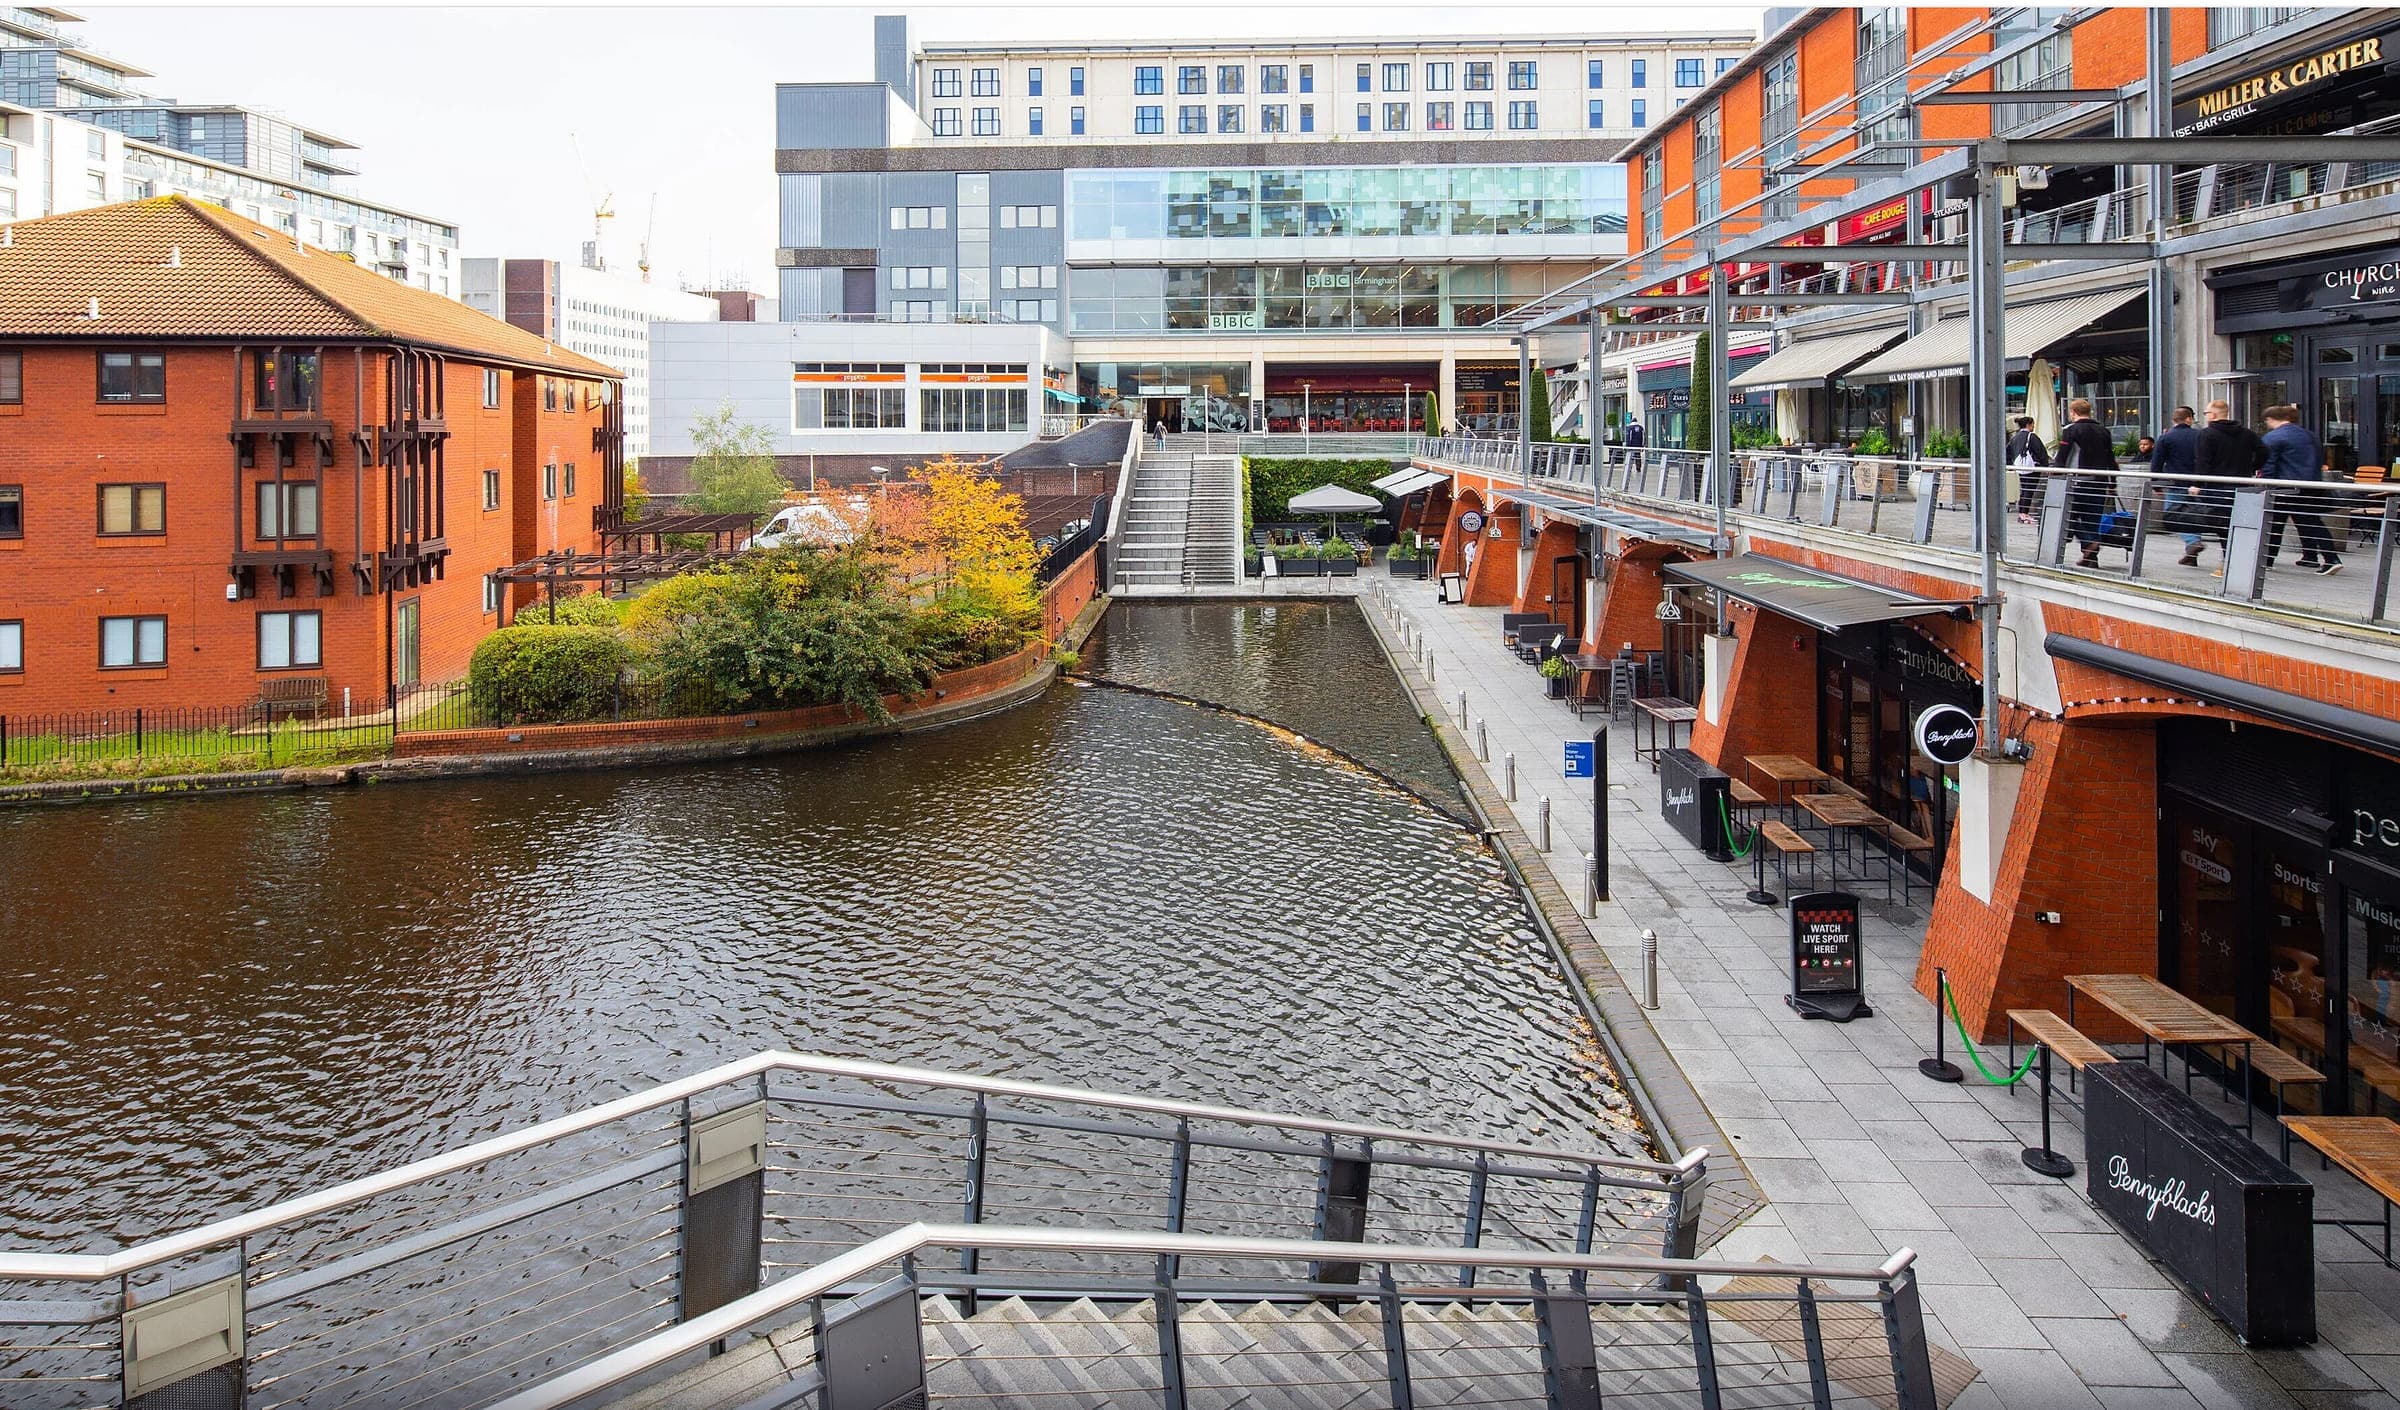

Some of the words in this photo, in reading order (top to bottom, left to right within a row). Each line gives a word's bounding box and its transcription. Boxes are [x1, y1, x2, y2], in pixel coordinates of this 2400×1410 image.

[2198, 77, 2267, 118] MILLER
[2269, 70, 2290, 94] &
[2289, 37, 2382, 87] CARTER
[2195, 116, 2218, 131] BAR
[2222, 103, 2257, 121] GRILL
[1881, 203, 1906, 222] ROUGE
[1933, 201, 1968, 219] STEAKHOUS
[1308, 275, 1349, 287] BBC
[1354, 276, 1398, 286] Birmingham
[2371, 285, 2396, 295] wine
[1212, 316, 1255, 328] BBC
[1889, 374, 1898, 382] ALL
[1898, 373, 1907, 381] DAY
[1926, 370, 1937, 379] AND
[1927, 727, 1974, 747] Pennyblacks
[2192, 827, 2218, 853] sky
[2185, 854, 2200, 866] BT
[2200, 859, 2225, 879] Sport
[2274, 862, 2320, 894] Sports
[1810, 924, 1841, 933] WATCH
[1803, 935, 1821, 943] LIVE
[1822, 935, 1849, 943] SPORT
[1814, 945, 1838, 954] HERE!
[2108, 1155, 2216, 1226] Pennyblacks
